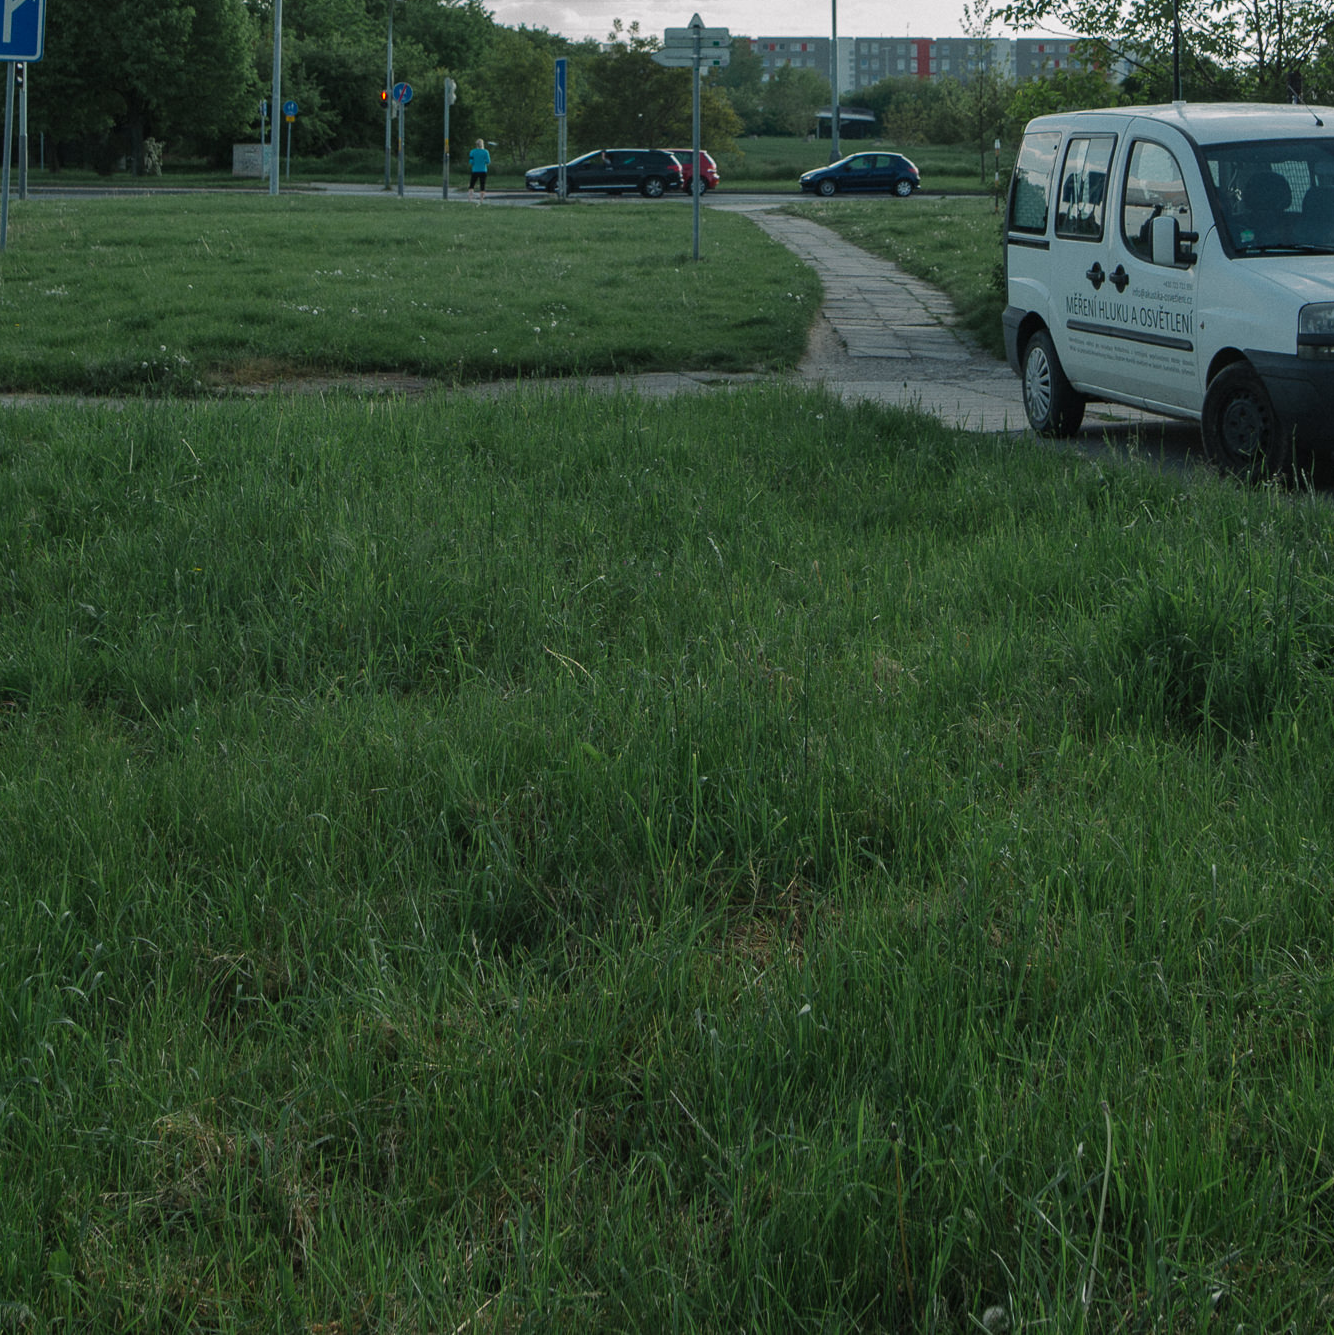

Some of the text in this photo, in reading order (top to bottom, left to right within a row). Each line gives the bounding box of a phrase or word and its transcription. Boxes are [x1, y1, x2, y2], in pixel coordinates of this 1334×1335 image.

[1066, 293, 1193, 334] MĚŘENÍ HLUKU A OSVĚTLENÍ
